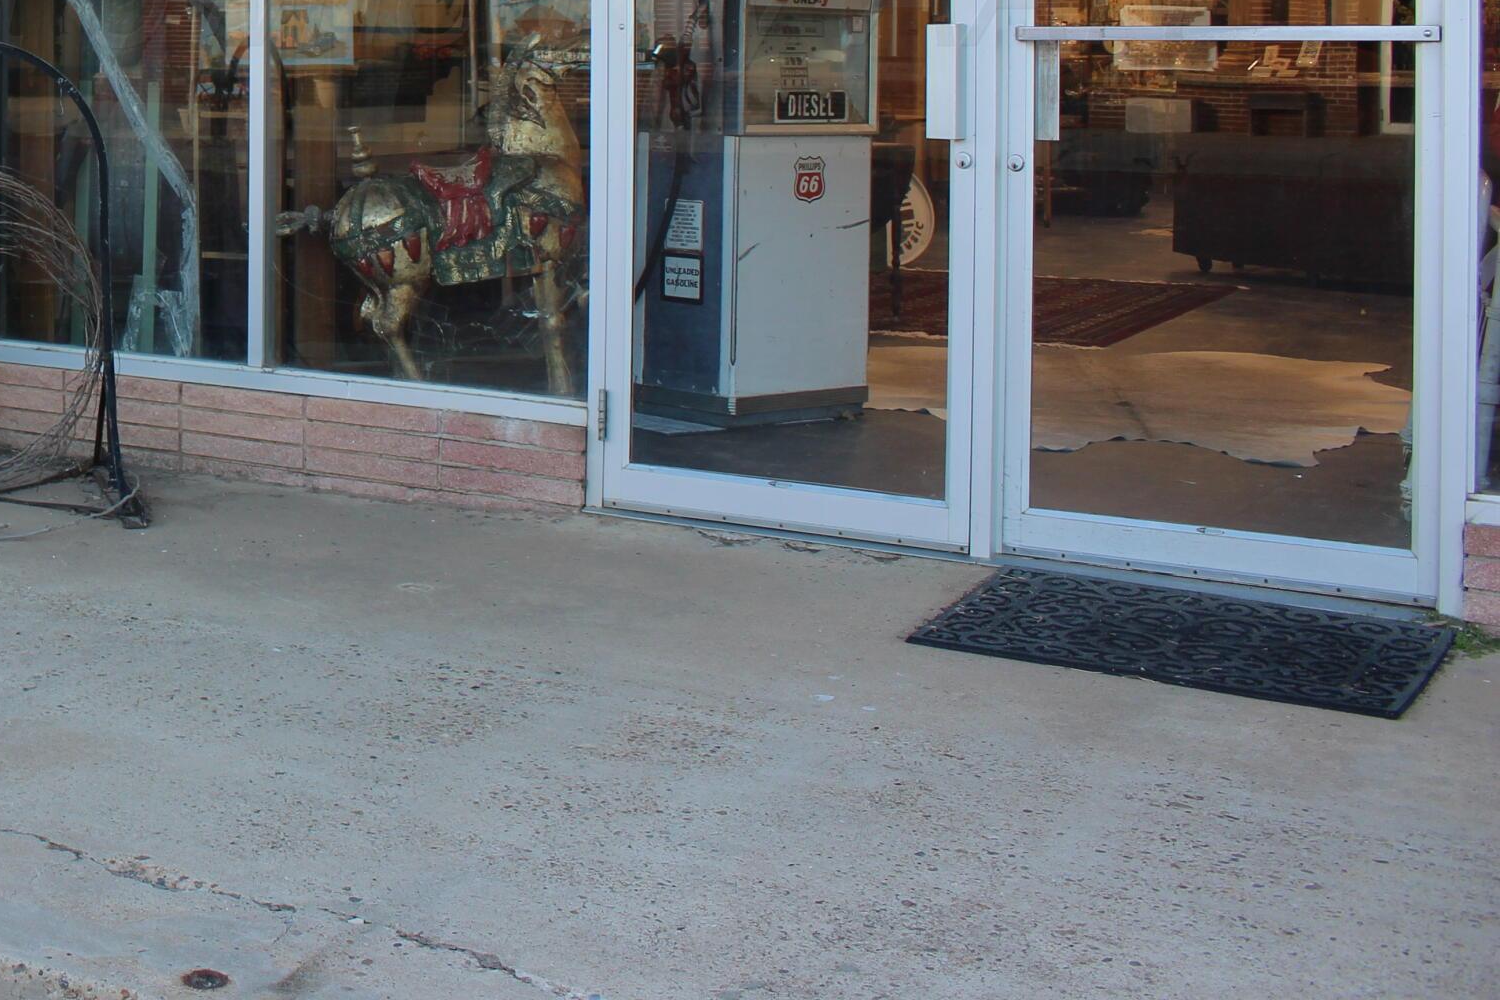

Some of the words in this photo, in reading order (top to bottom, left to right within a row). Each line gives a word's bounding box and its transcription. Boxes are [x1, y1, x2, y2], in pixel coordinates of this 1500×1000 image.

[788, 94, 835, 117] DIESEL
[798, 162, 821, 171] PHILLIPS
[799, 175, 820, 193] 66
[665, 266, 700, 277] UNLEADED
[666, 278, 699, 289] GASOLINE
